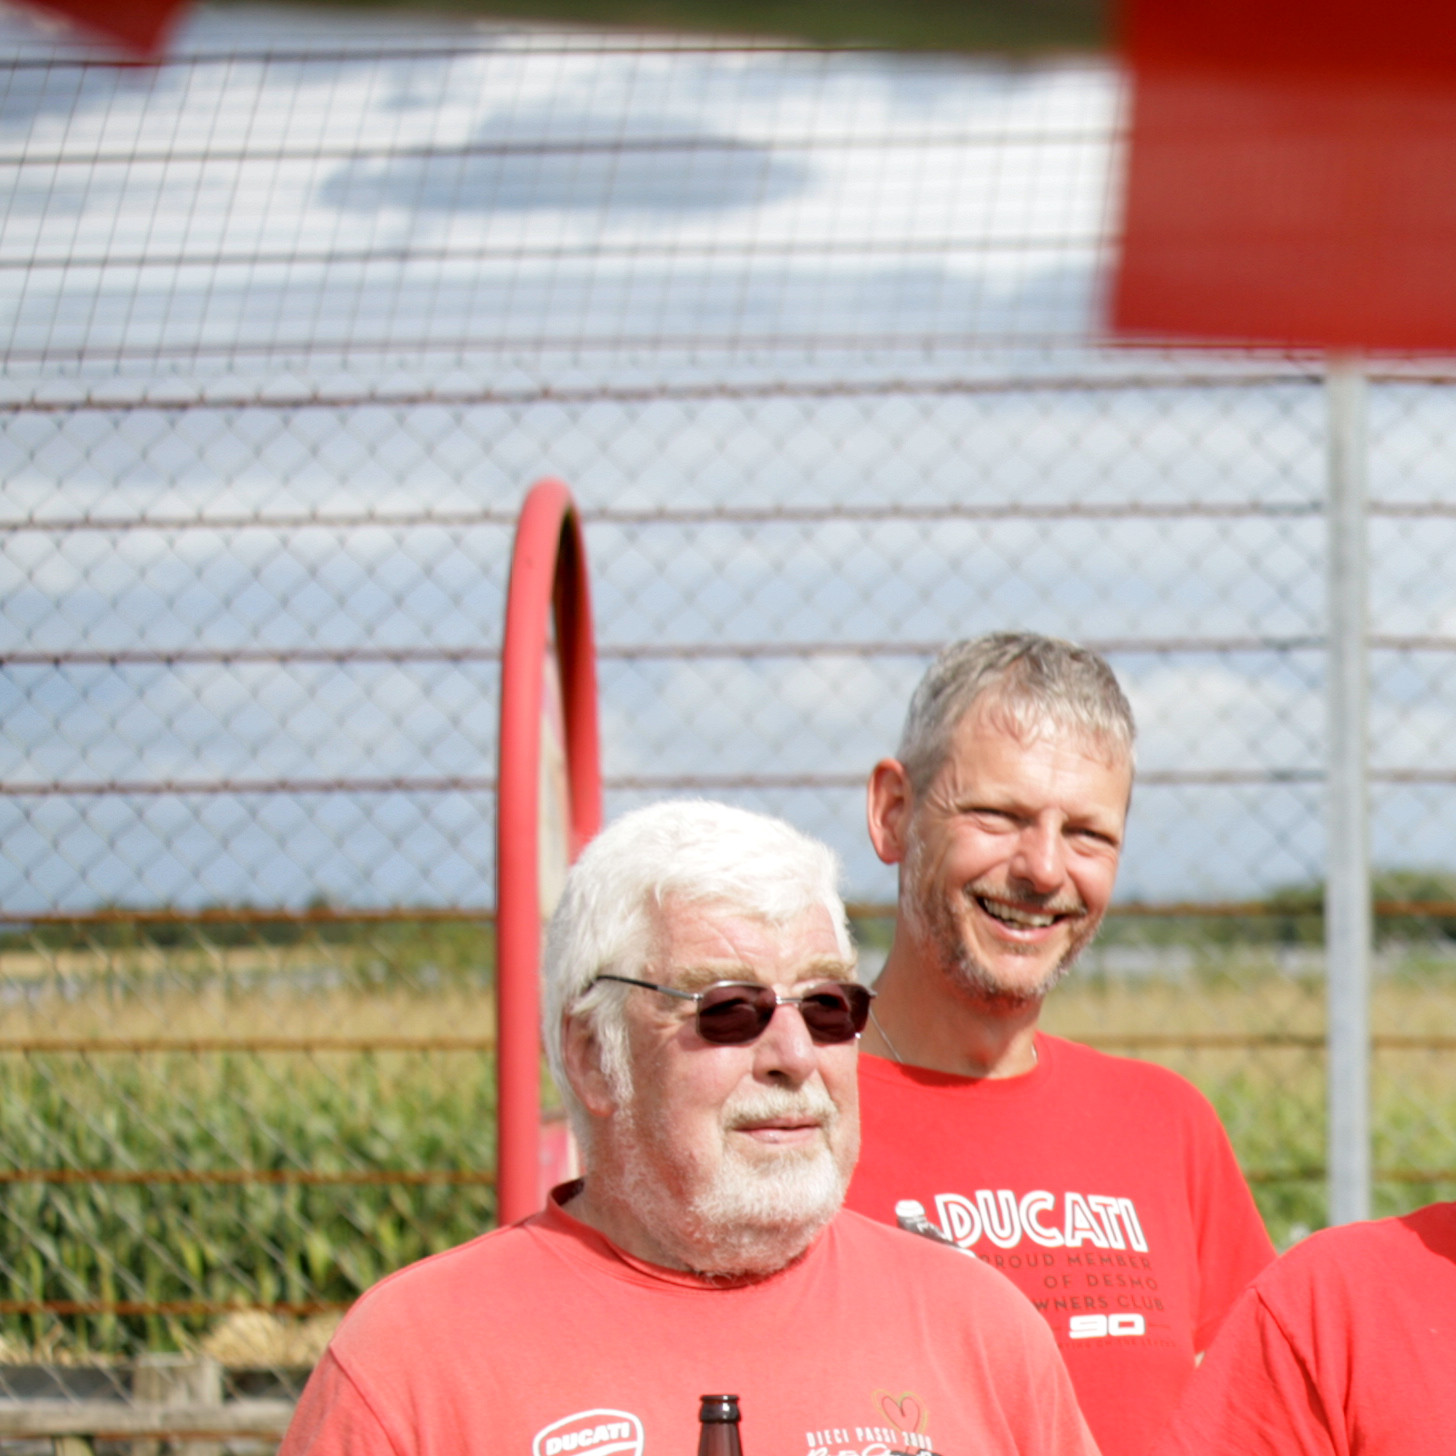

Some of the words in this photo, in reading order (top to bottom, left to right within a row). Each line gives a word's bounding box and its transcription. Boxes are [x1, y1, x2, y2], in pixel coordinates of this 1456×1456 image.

[934, 1189, 1149, 1253] DUCATI
[1067, 1254, 1152, 1271] MEMBER
[1044, 1275, 1073, 1289] OF
[1086, 1274, 1158, 1290] DESMO
[1034, 1296, 1108, 1311] WNERS
[1116, 1296, 1164, 1311] CLUB
[1069, 1313, 1145, 1339] 90
[545, 1422, 631, 1456] DUCATI
[806, 1428, 850, 1448] DIECI
[855, 1426, 898, 1444] PASSI
